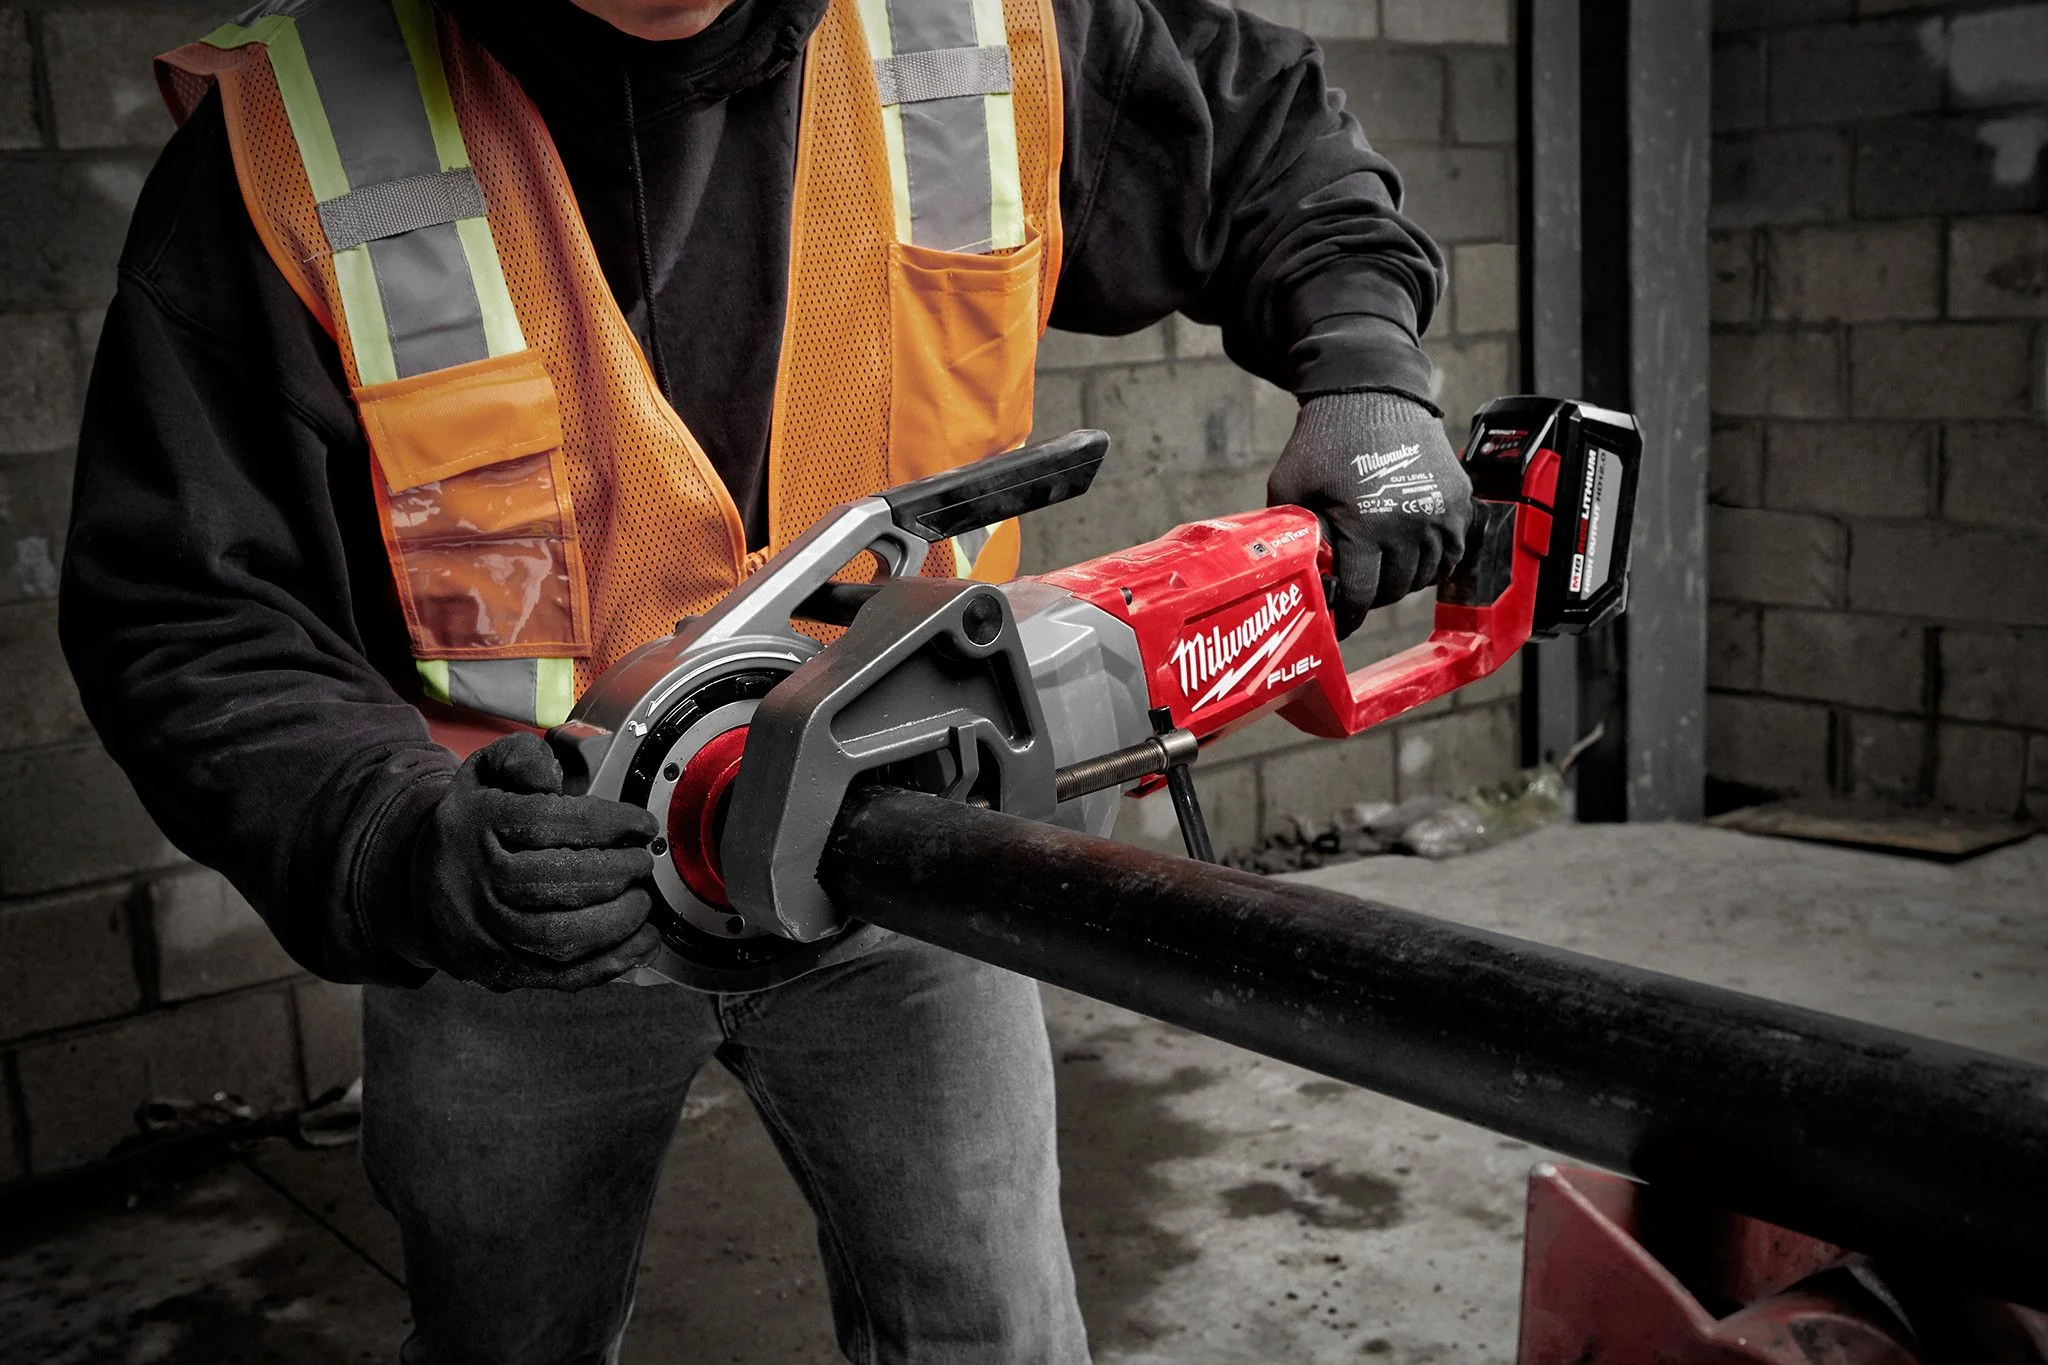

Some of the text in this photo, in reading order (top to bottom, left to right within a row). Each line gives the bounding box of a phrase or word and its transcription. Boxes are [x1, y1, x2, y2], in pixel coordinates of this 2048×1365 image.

[1351, 443, 1420, 476] Milwaukee
[1390, 475, 1406, 483] CUT
[1384, 498, 1398, 507] XL
[1584, 452, 1606, 593] HIGH OUTPUT HD12.0
[1572, 556, 1582, 589] M18
[1170, 583, 1303, 697] Milwaukee
[1266, 654, 1323, 690] FUEL
